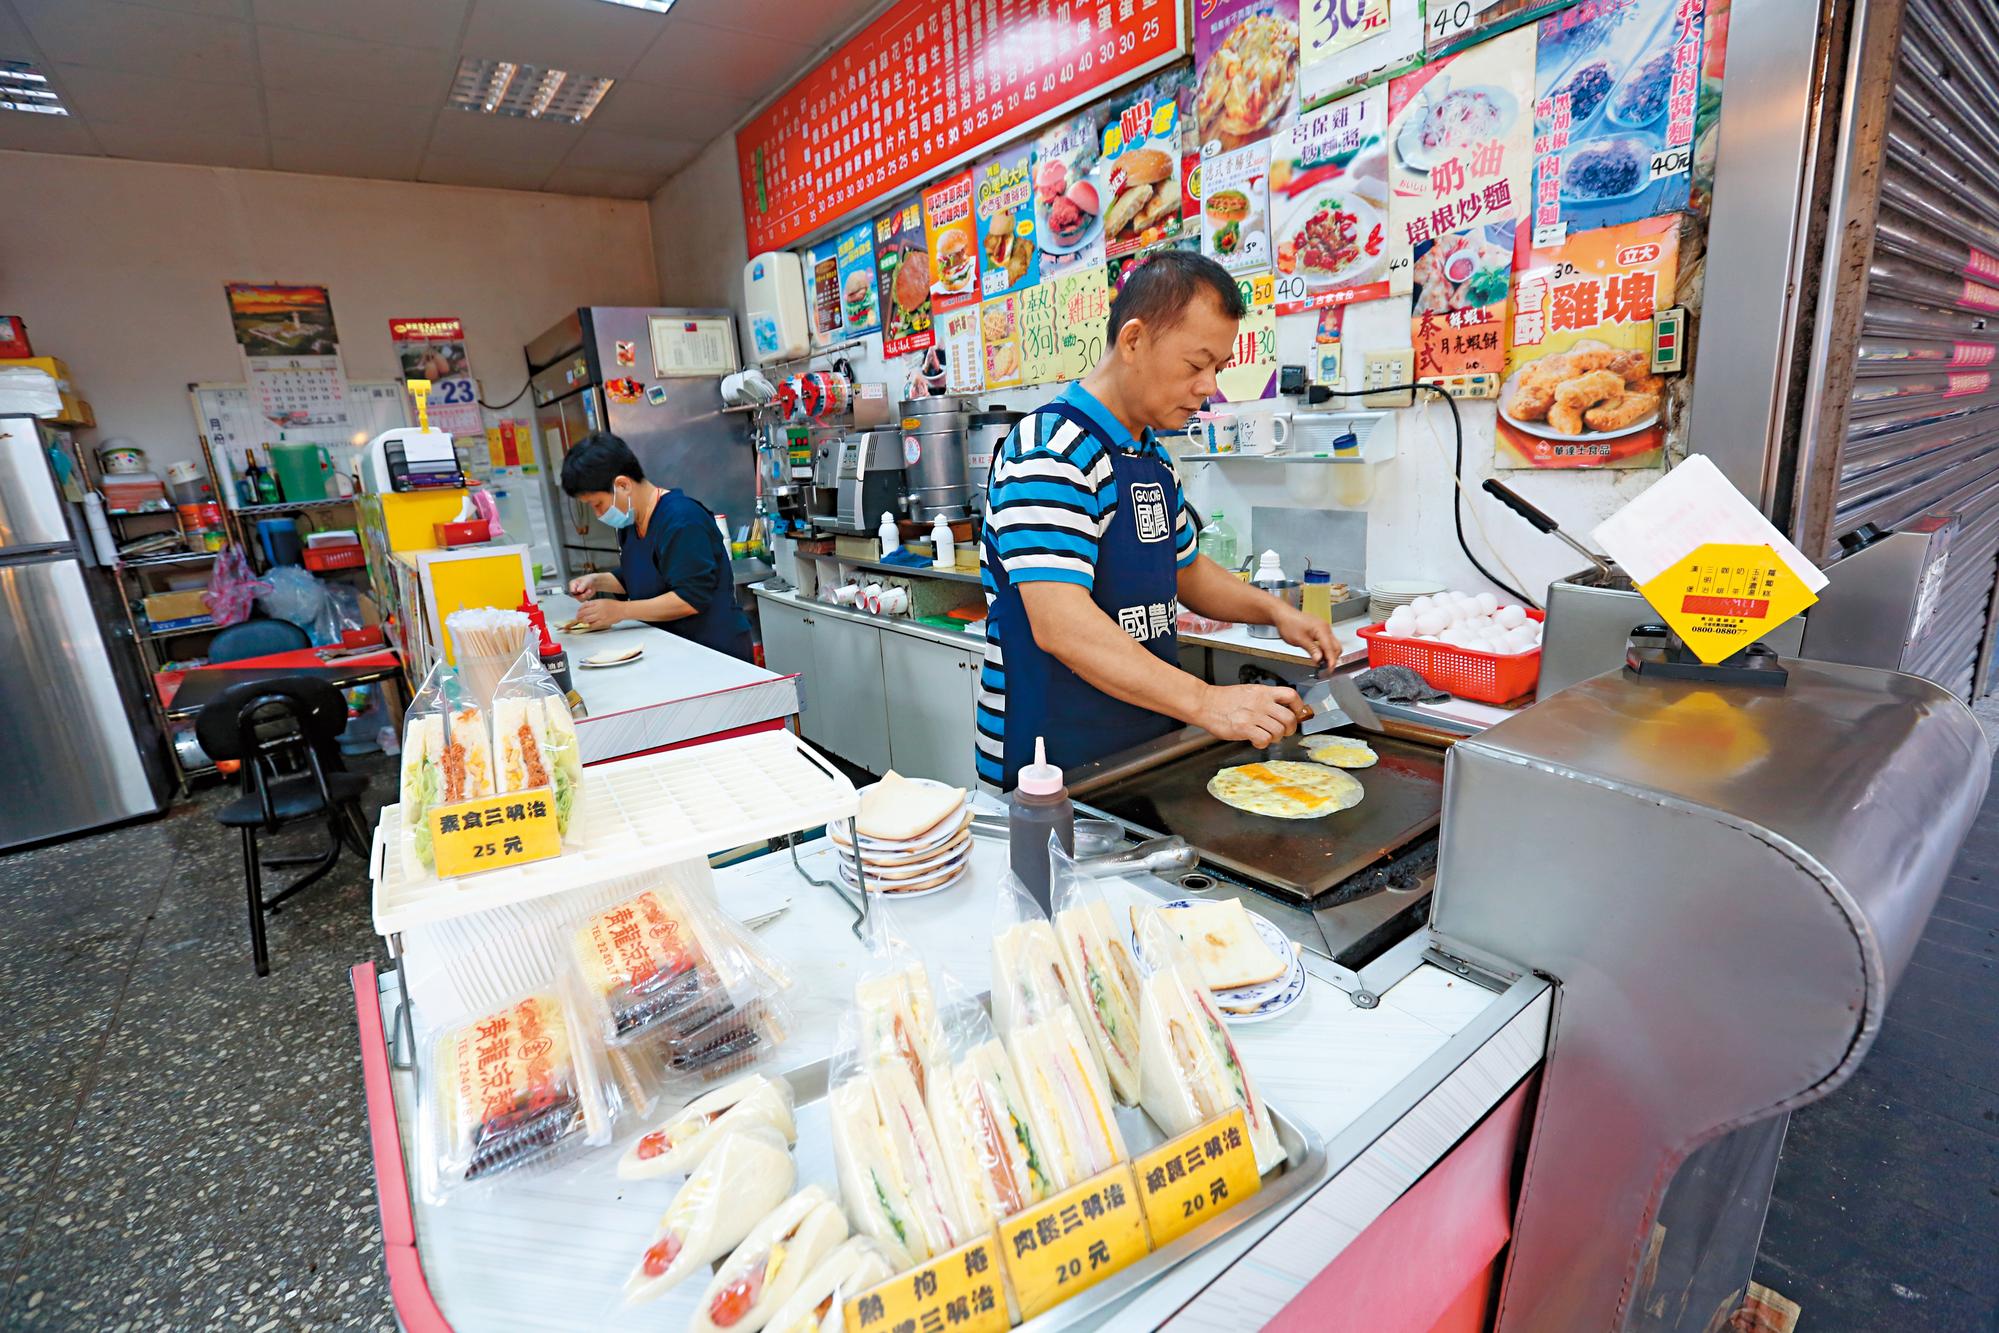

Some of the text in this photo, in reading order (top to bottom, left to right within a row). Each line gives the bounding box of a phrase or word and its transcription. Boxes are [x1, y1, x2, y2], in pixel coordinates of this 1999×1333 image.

[1142, 16, 1160, 43] 25
[1363, 8, 1387, 33] 元
[1434, 1, 1470, 36] 40
[1099, 41, 1115, 65] 30
[1119, 30, 1136, 55] 30
[1060, 63, 1074, 84] 40
[1078, 52, 1093, 73] 40
[927, 12, 945, 149] 花生土司 15
[1023, 80, 1037, 101] 45
[1042, 73, 1056, 93] 40
[991, 99, 1004, 121] 25
[1007, 91, 1020, 111] 20
[962, 117, 974, 136] 30
[976, 108, 989, 129] 25
[1292, 98, 1371, 144] 宮保雞丁
[923, 139, 932, 155] 15
[948, 125, 960, 145] 30
[898, 152, 909, 170] 25
[911, 146, 920, 162] 15
[1651, 153, 1692, 174] 40元
[876, 166, 886, 182] 25
[887, 159, 897, 176] 25
[1431, 139, 1505, 201] 奶油
[1537, 156, 1560, 226] 肉醬麵
[1405, 178, 1512, 246] 培根炒麵
[1390, 257, 1409, 271] 40
[1623, 246, 1655, 264] 立大
[1255, 282, 1272, 300] 50
[1278, 276, 1305, 300] 40
[1514, 278, 1548, 346] 香酥
[1550, 272, 1656, 332] 雞塊
[1027, 286, 1054, 358] 熱狗
[1257, 330, 1275, 356] 30
[1418, 309, 1443, 373] 泰式
[1441, 332, 1498, 354] 月亮蝦餅
[1077, 336, 1102, 373] 30
[441, 380, 475, 404] 23
[440, 799, 547, 835] 素食三明治
[473, 835, 524, 859] 25 元
[1144, 1126, 1242, 1195] 總匯三明治
[1183, 1176, 1229, 1218] 20 元
[1012, 1183, 1127, 1260] 肉鬆三明治
[1056, 1239, 1111, 1285] 20 元
